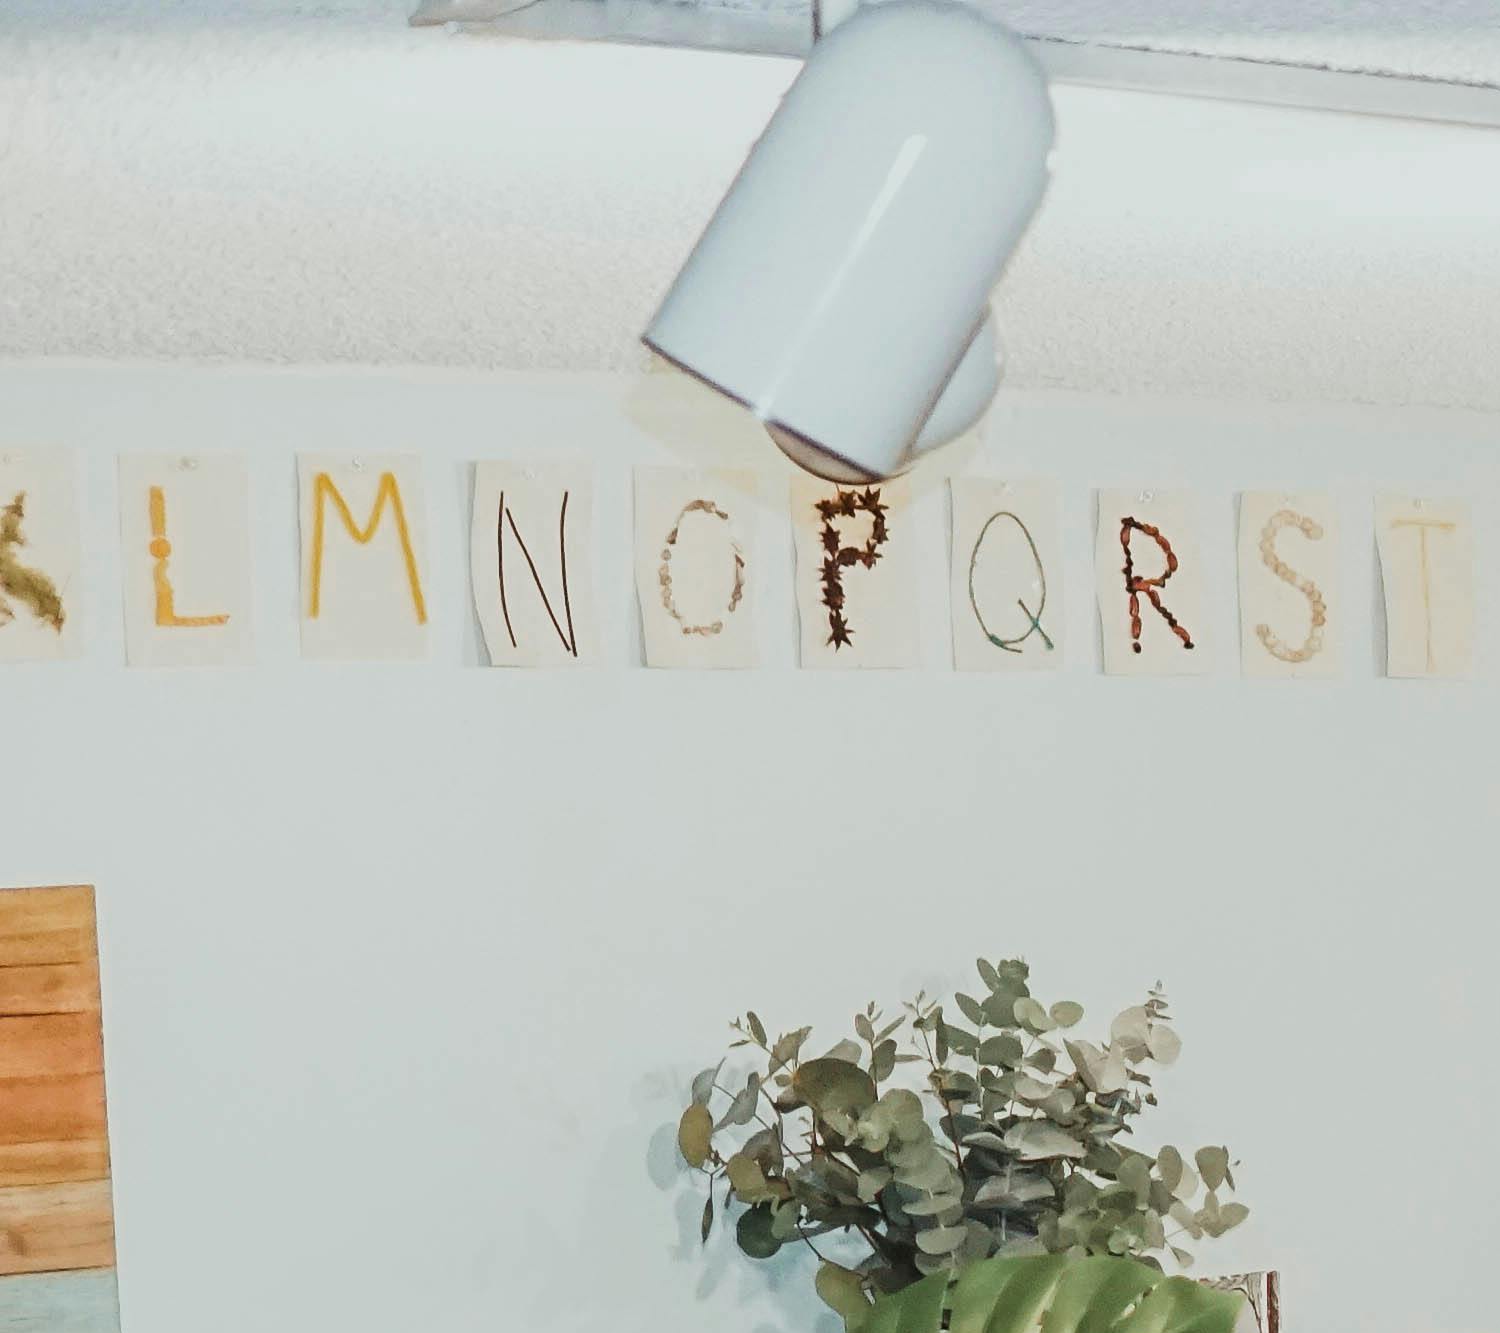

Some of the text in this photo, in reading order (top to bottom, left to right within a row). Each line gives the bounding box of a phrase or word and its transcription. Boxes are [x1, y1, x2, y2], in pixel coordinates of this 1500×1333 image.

[148, 485, 230, 627] L
[308, 472, 427, 625] M
[498, 490, 578, 657] N
[660, 499, 746, 636] O
[819, 485, 888, 651] P
[968, 510, 1054, 654] Q
[1120, 515, 1195, 654] R
[1254, 509, 1327, 663] S
[1388, 518, 1456, 671] T
